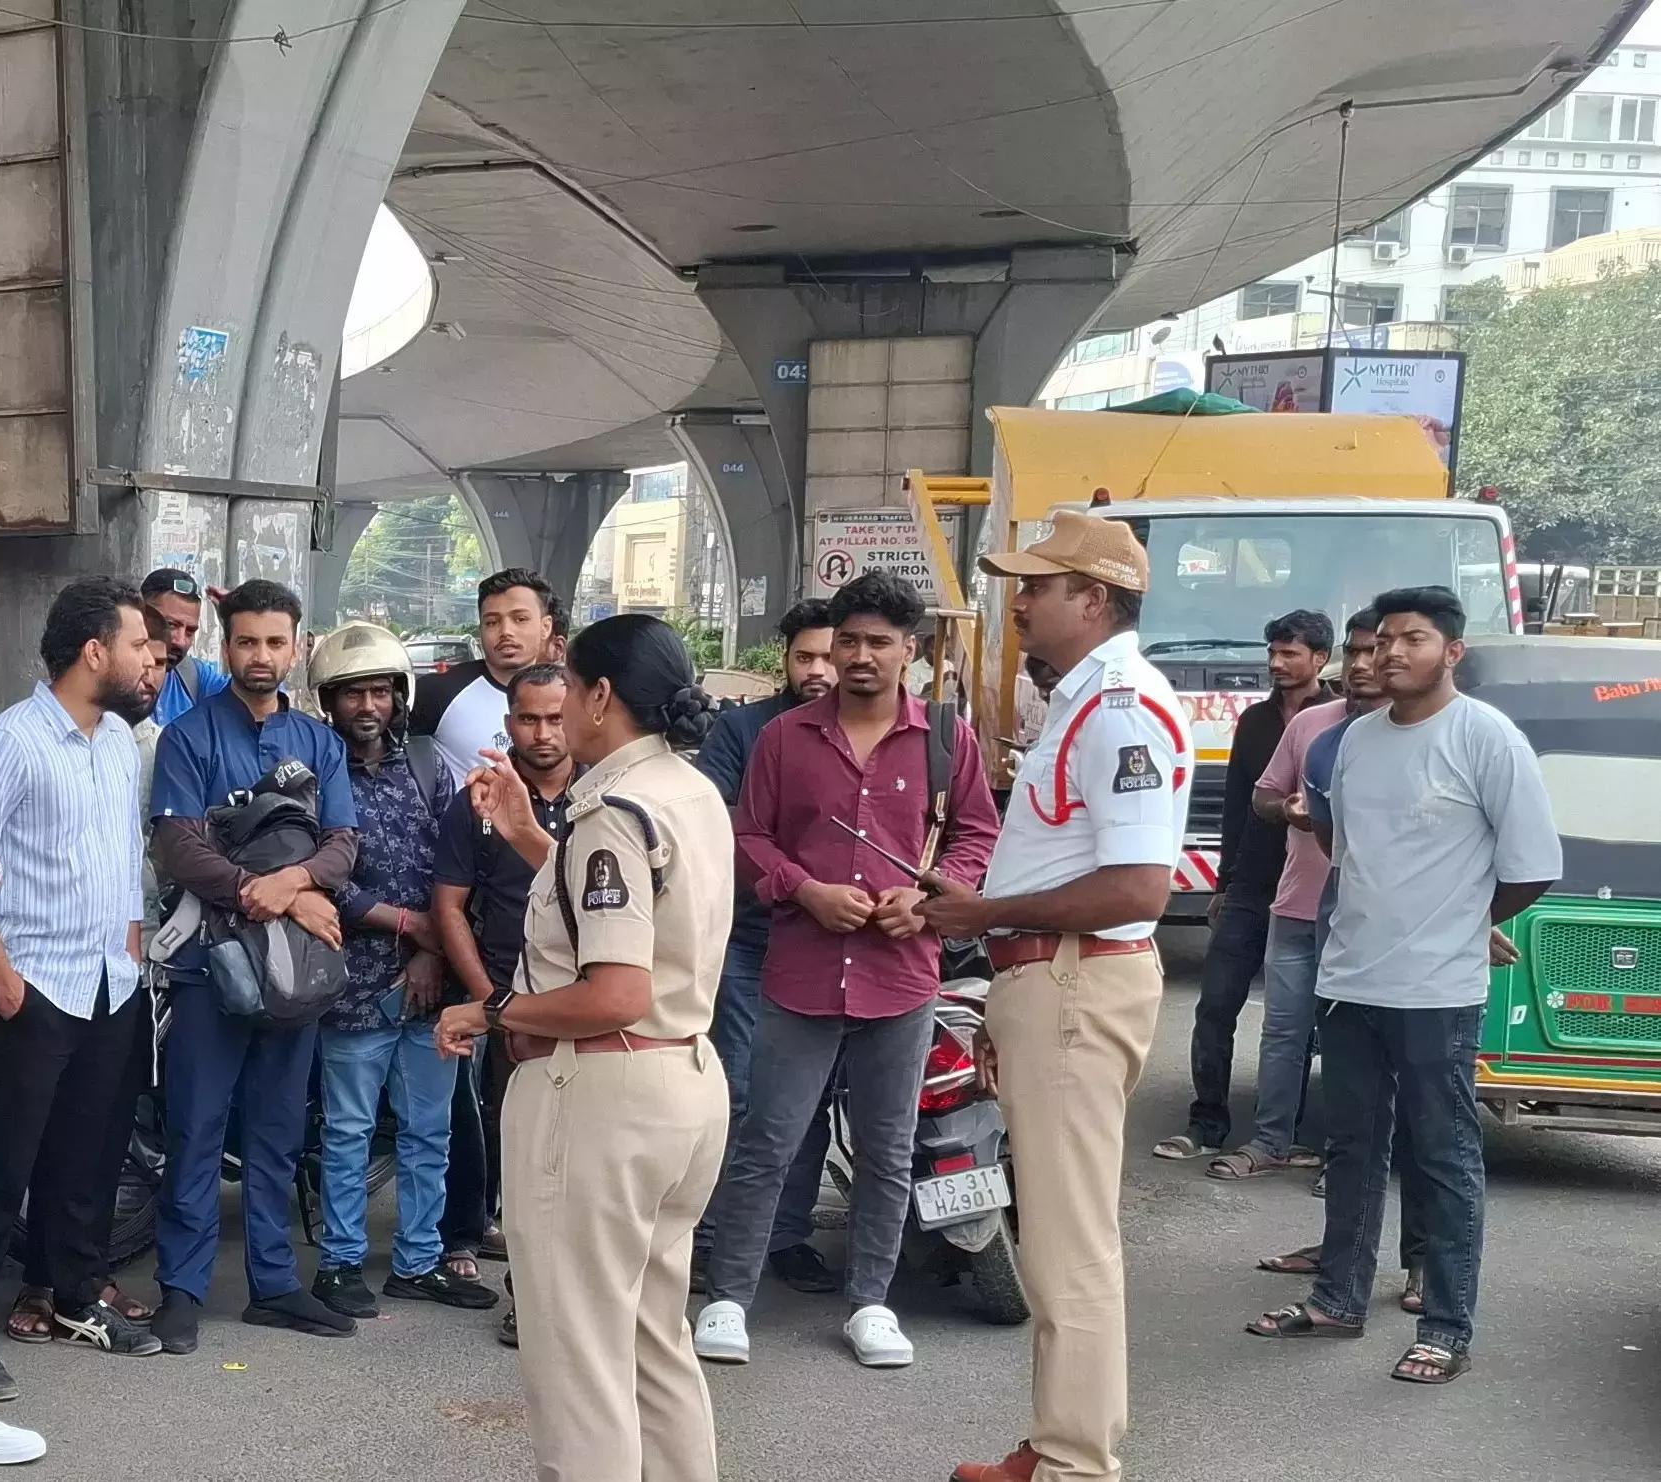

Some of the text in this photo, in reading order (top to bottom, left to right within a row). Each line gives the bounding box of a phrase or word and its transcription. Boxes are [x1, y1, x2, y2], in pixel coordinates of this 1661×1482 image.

[1368, 361, 1416, 378] MYTHRI
[844, 525, 875, 535] TAKE
[818, 536, 834, 546] AT
[836, 536, 878, 546] PILLAR
[880, 536, 901, 546] NO.
[866, 550, 927, 562] STRICTL
[887, 564, 931, 577] WRON
[1119, 779, 1158, 791] POLICE
[586, 891, 622, 907] POLICE
[930, 1170, 990, 1198] TS 31
[934, 1188, 997, 1217] H4901
